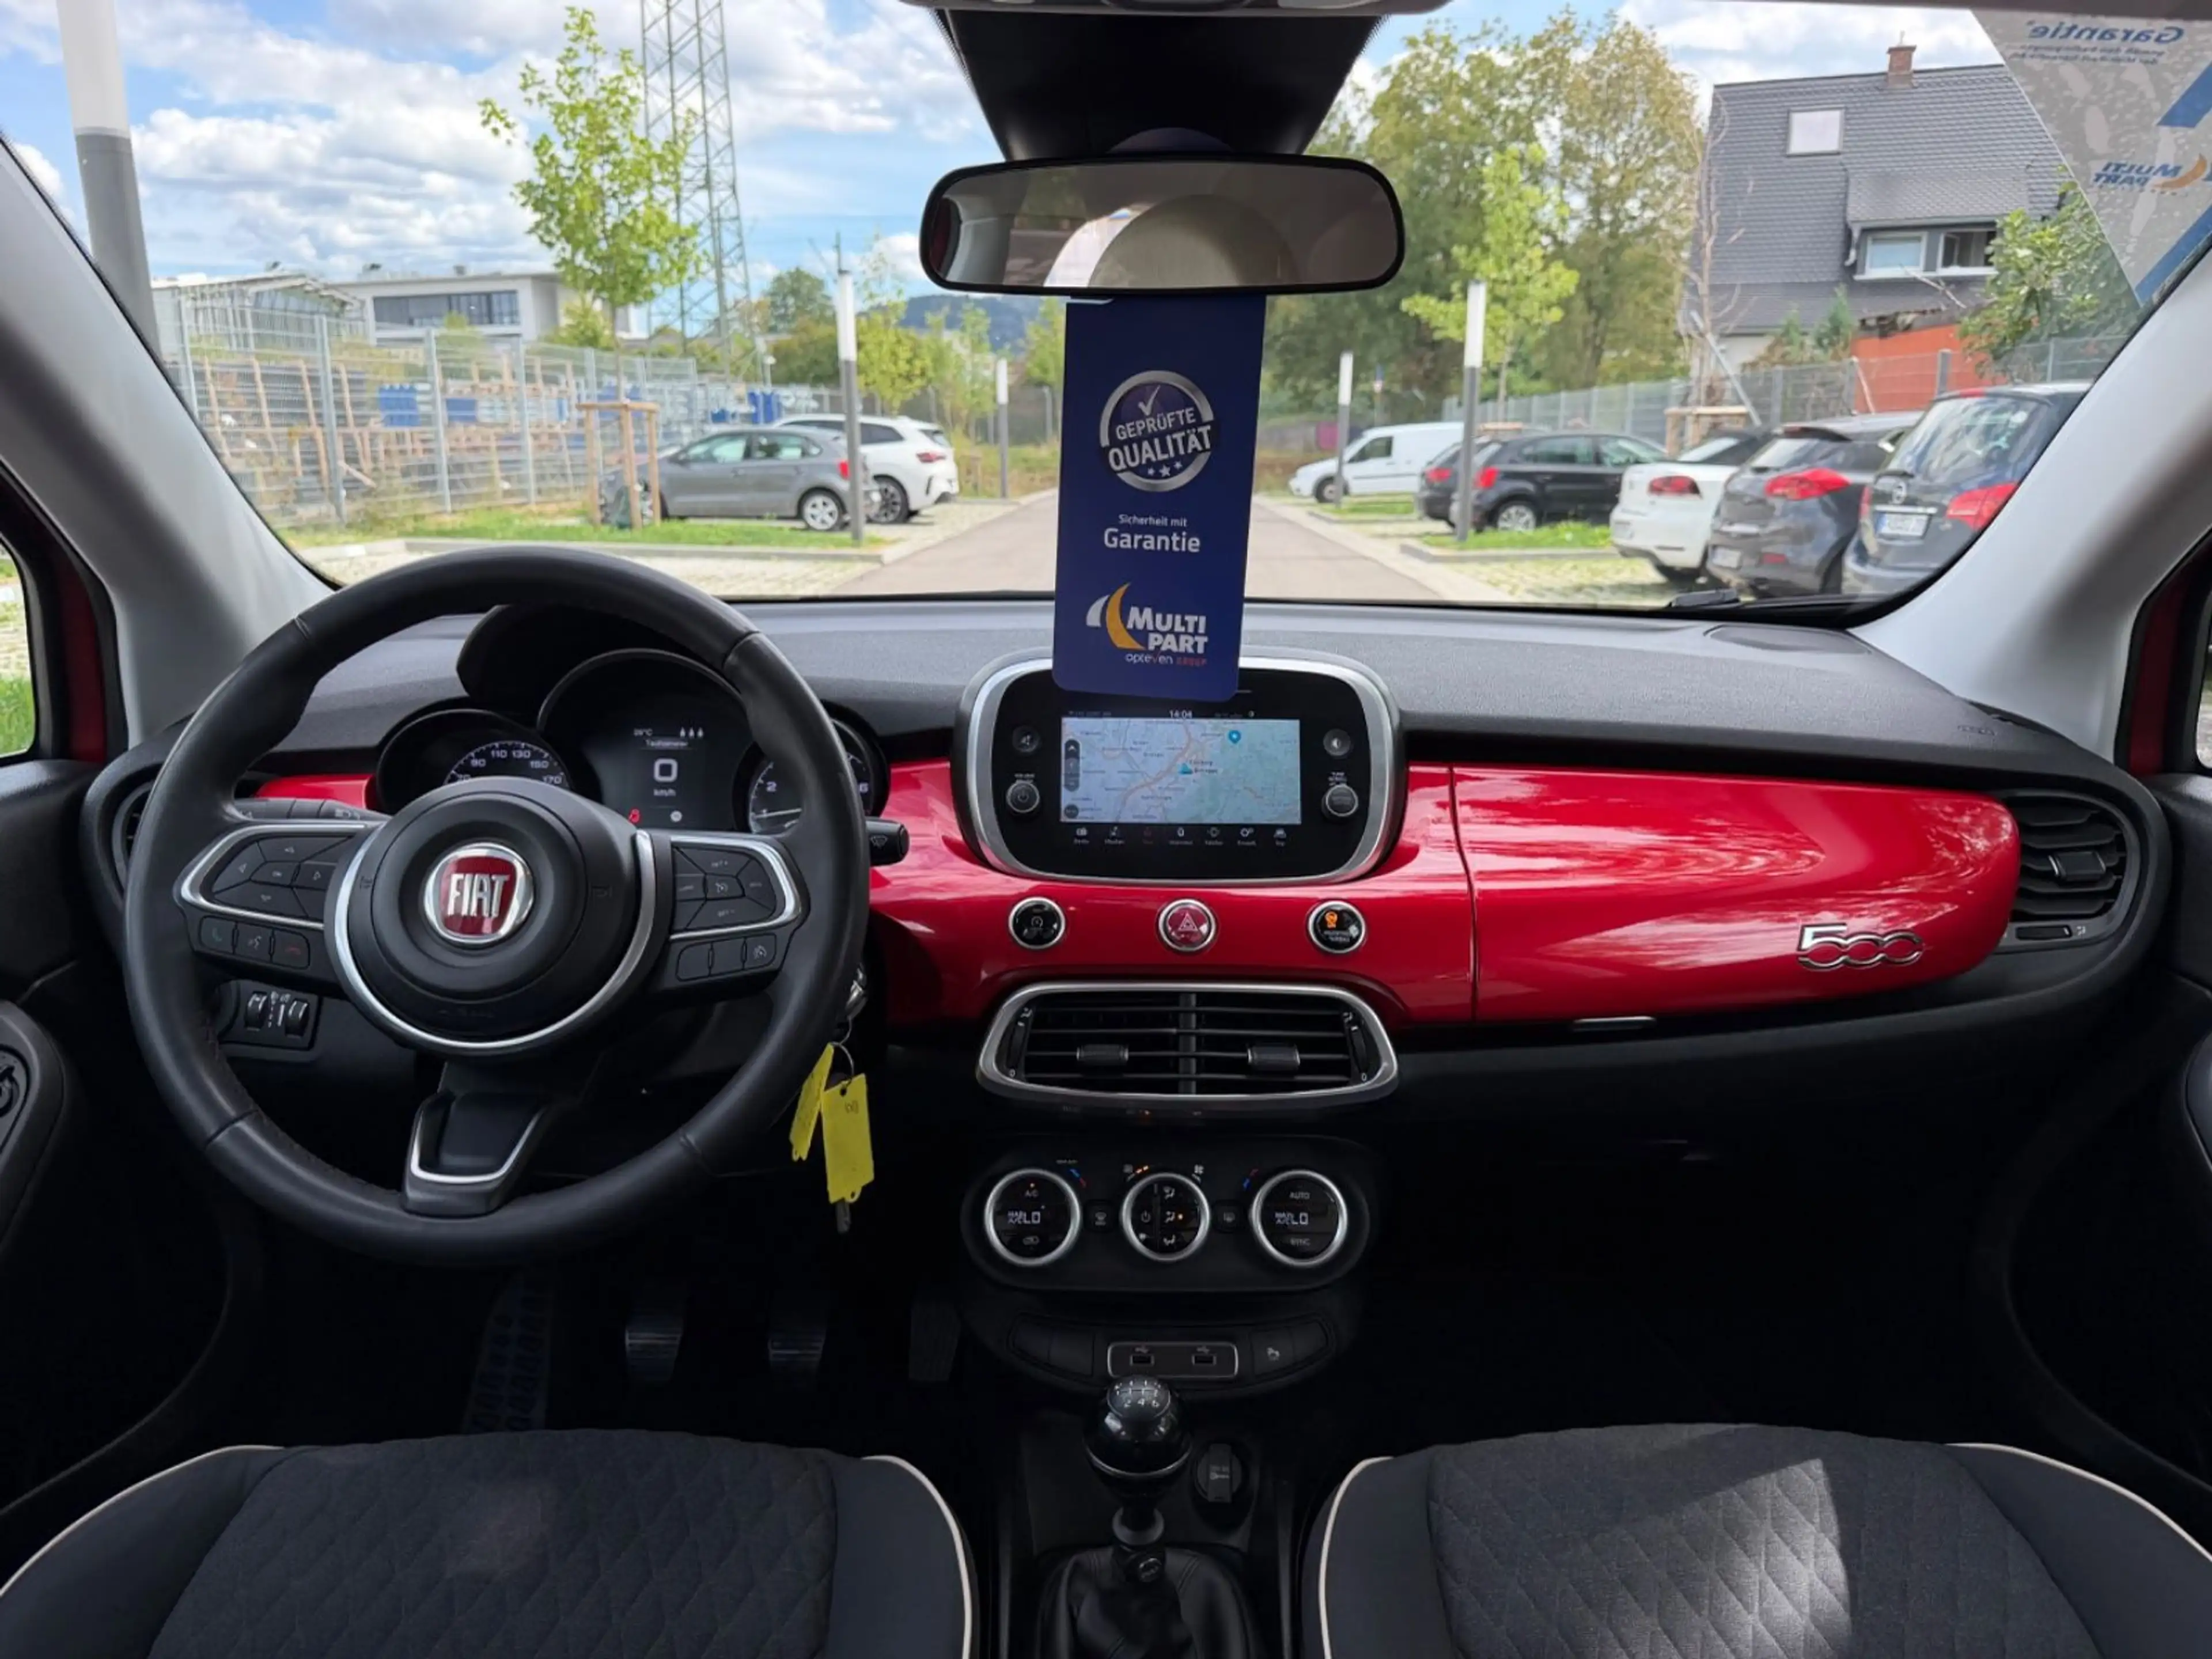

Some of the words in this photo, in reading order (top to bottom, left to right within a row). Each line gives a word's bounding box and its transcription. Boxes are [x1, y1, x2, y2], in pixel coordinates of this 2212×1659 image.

[1116, 407, 1196, 440] GEPRÜFTE
[1108, 425, 1211, 472] QUALITÄT
[1118, 514, 1168, 527] Sicherheit
[1171, 516, 1187, 527] mit
[1104, 528, 1200, 552] Garantie
[1127, 606, 1206, 634] MULTI
[1148, 632, 1209, 654] PART
[1125, 652, 1173, 664] opteven
[491, 750, 507, 759] 110
[513, 750, 531, 759] 130
[653, 758, 678, 782] 0
[766, 781, 777, 792] 2
[447, 873, 511, 918] FIAT
[1796, 922, 1924, 972] 500
[1289, 1192, 1310, 1200] AUTO
